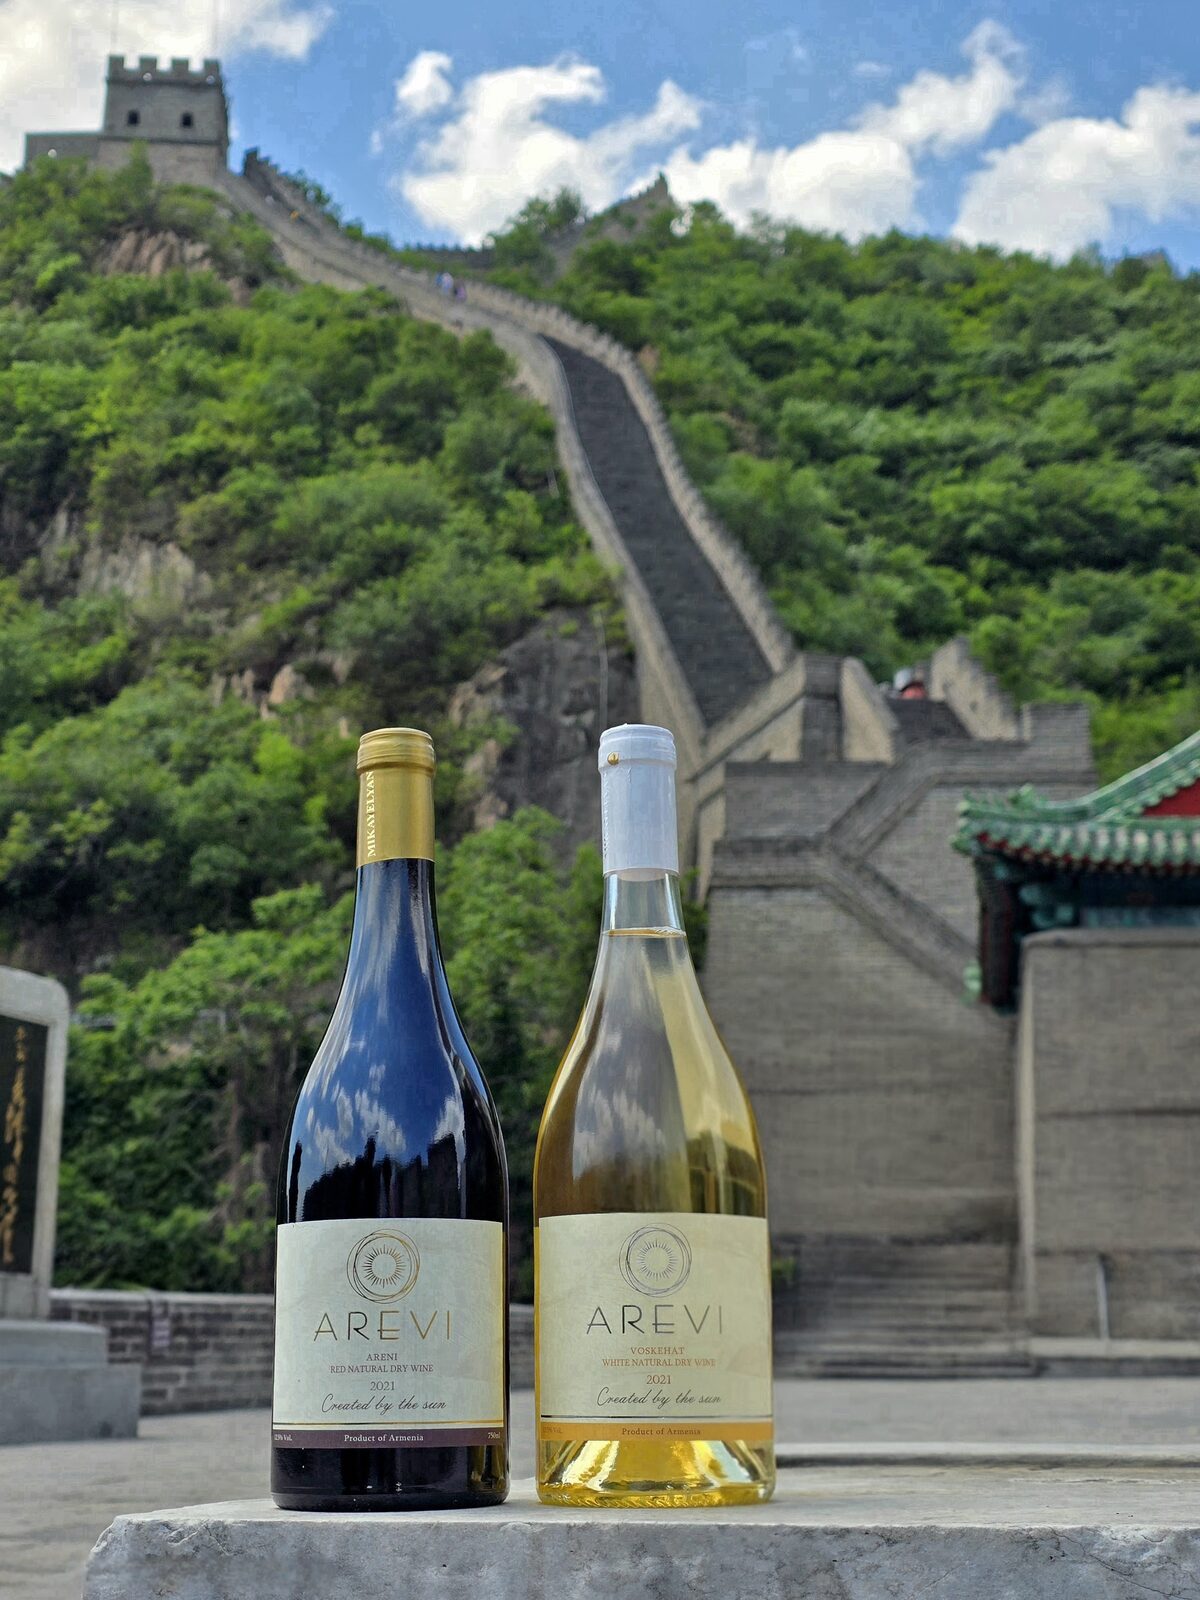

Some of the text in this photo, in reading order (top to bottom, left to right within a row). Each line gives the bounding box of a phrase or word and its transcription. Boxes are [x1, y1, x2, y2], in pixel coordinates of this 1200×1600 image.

[586, 1304, 722, 1335] AREVI
[313, 1310, 450, 1342] AREVI
[630, 1346, 685, 1355] VOSKEHAT
[366, 1353, 398, 1361] ARENI
[602, 1358, 716, 1367] WHITE NATURAL DRY WINE
[330, 1364, 434, 1374] RED NATURAL DRY WINE
[646, 1375, 672, 1385] 2021
[369, 1381, 395, 1391] 2021
[597, 1386, 721, 1410] Created by the sun
[321, 1393, 447, 1415] Created by the sun
[621, 1427, 701, 1436] Product of Armenia
[343, 1433, 424, 1442] Product of Armenia
